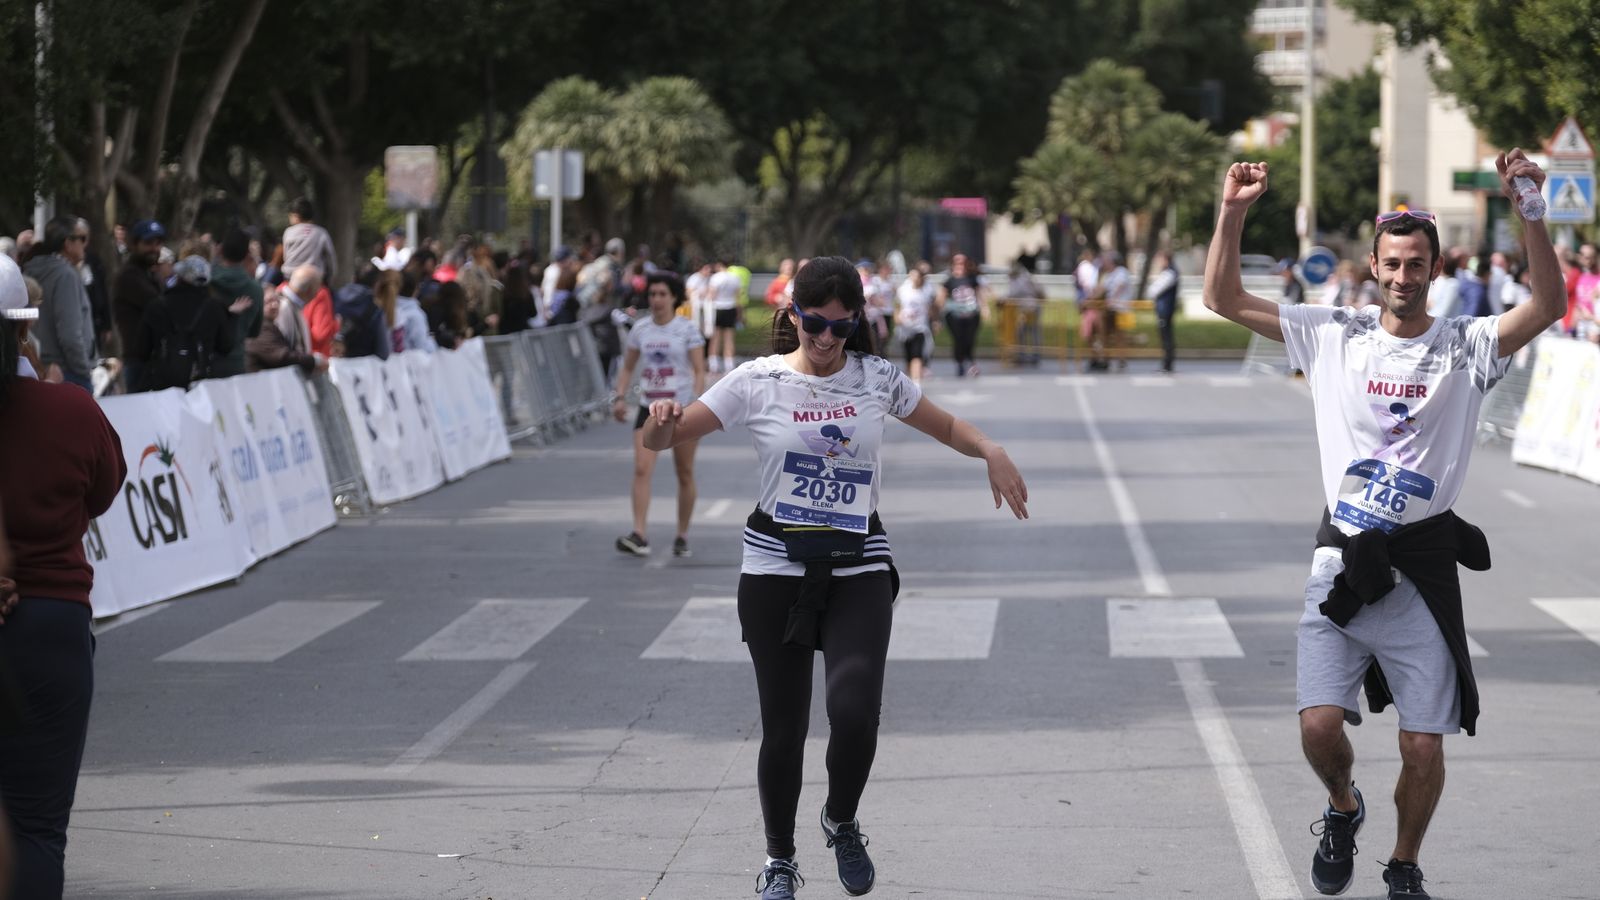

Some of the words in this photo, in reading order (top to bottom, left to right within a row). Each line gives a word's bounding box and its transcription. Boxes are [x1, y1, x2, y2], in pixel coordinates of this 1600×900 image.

[1373, 371, 1404, 381] CARRERA
[1416, 375, 1425, 383] LA
[1367, 380, 1428, 399] MUJER
[793, 405, 858, 422] MUJER
[795, 401, 829, 410] CARRERA
[830, 401, 841, 409] DE
[791, 475, 856, 505] 2030
[1363, 481, 1408, 513] 146
[125, 472, 188, 549] CASI
[811, 500, 834, 509] ELENA
[1358, 500, 1374, 510] JUAN
[1374, 506, 1402, 520] IGNACIO
